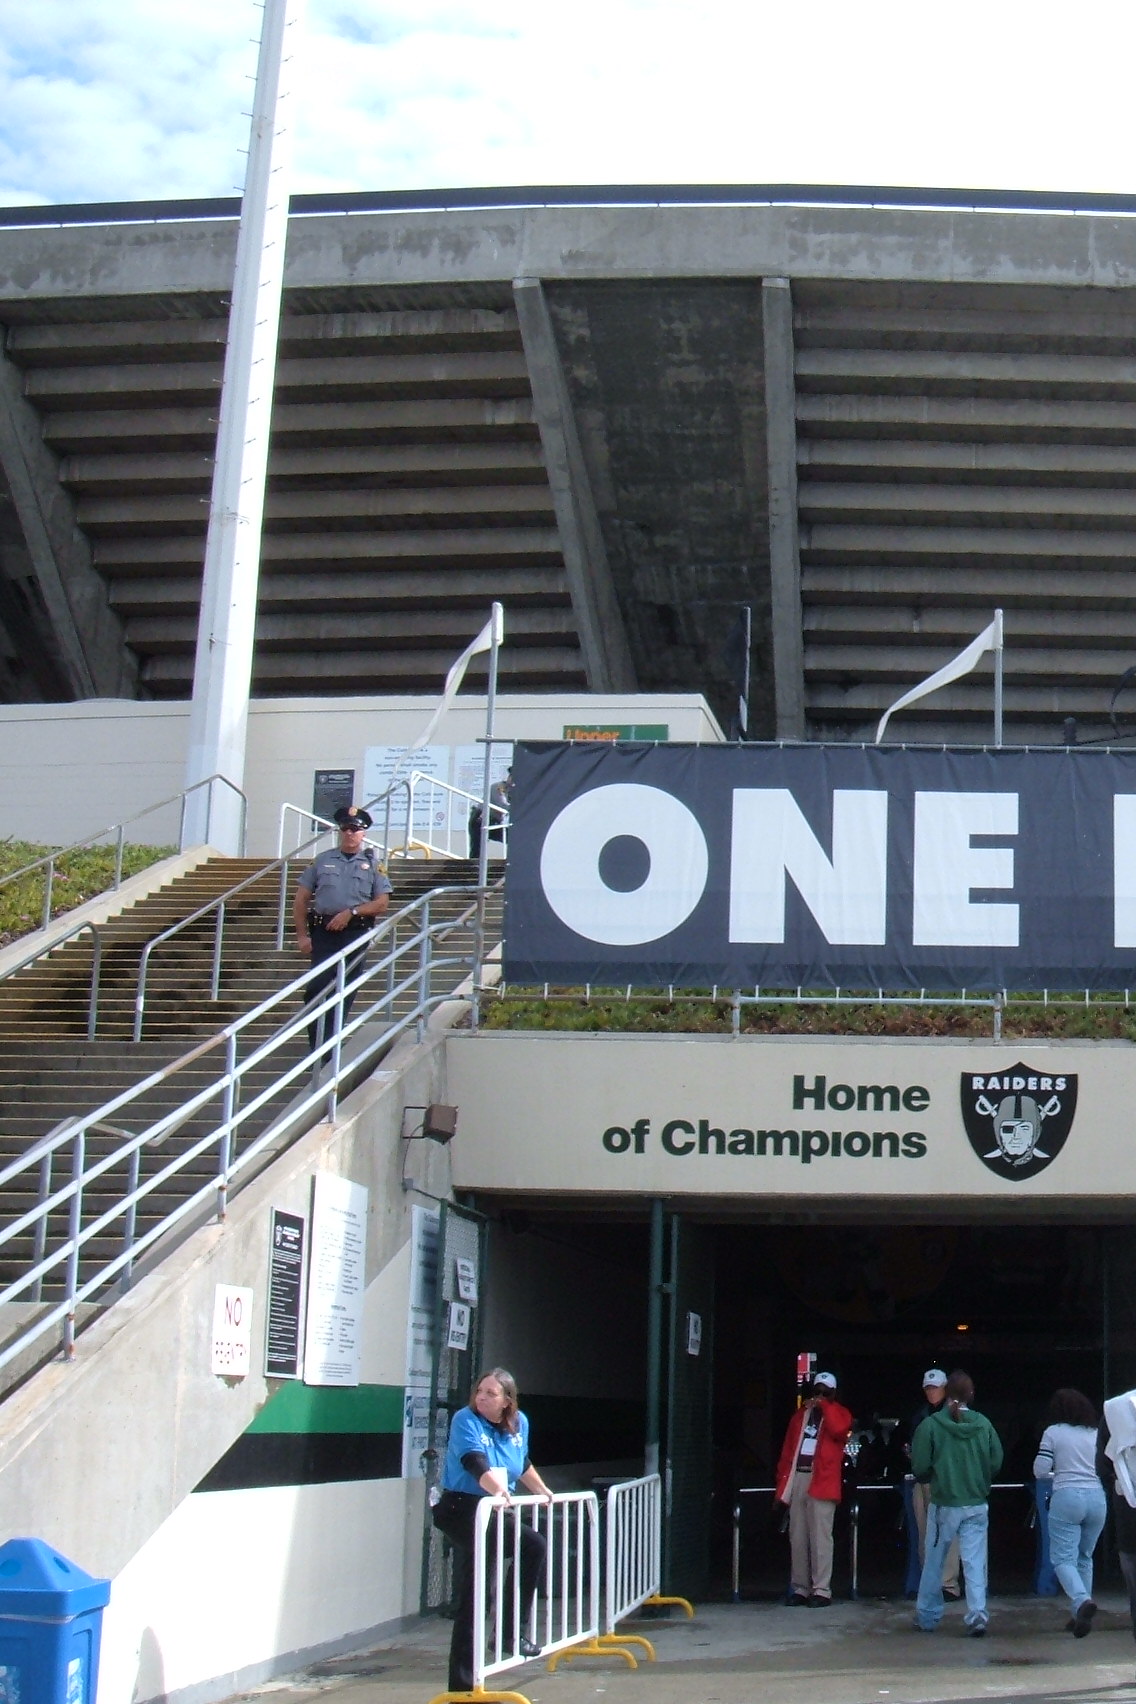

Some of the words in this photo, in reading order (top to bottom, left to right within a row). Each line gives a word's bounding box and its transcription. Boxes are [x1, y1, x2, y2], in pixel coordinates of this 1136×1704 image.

[540, 783, 1020, 947] ONE
[793, 1075, 930, 1113] Home
[972, 1076, 1068, 1091] RAIDERS
[603, 1119, 651, 1153] of
[661, 1120, 928, 1165] Champions
[225, 1296, 242, 1327] NO
